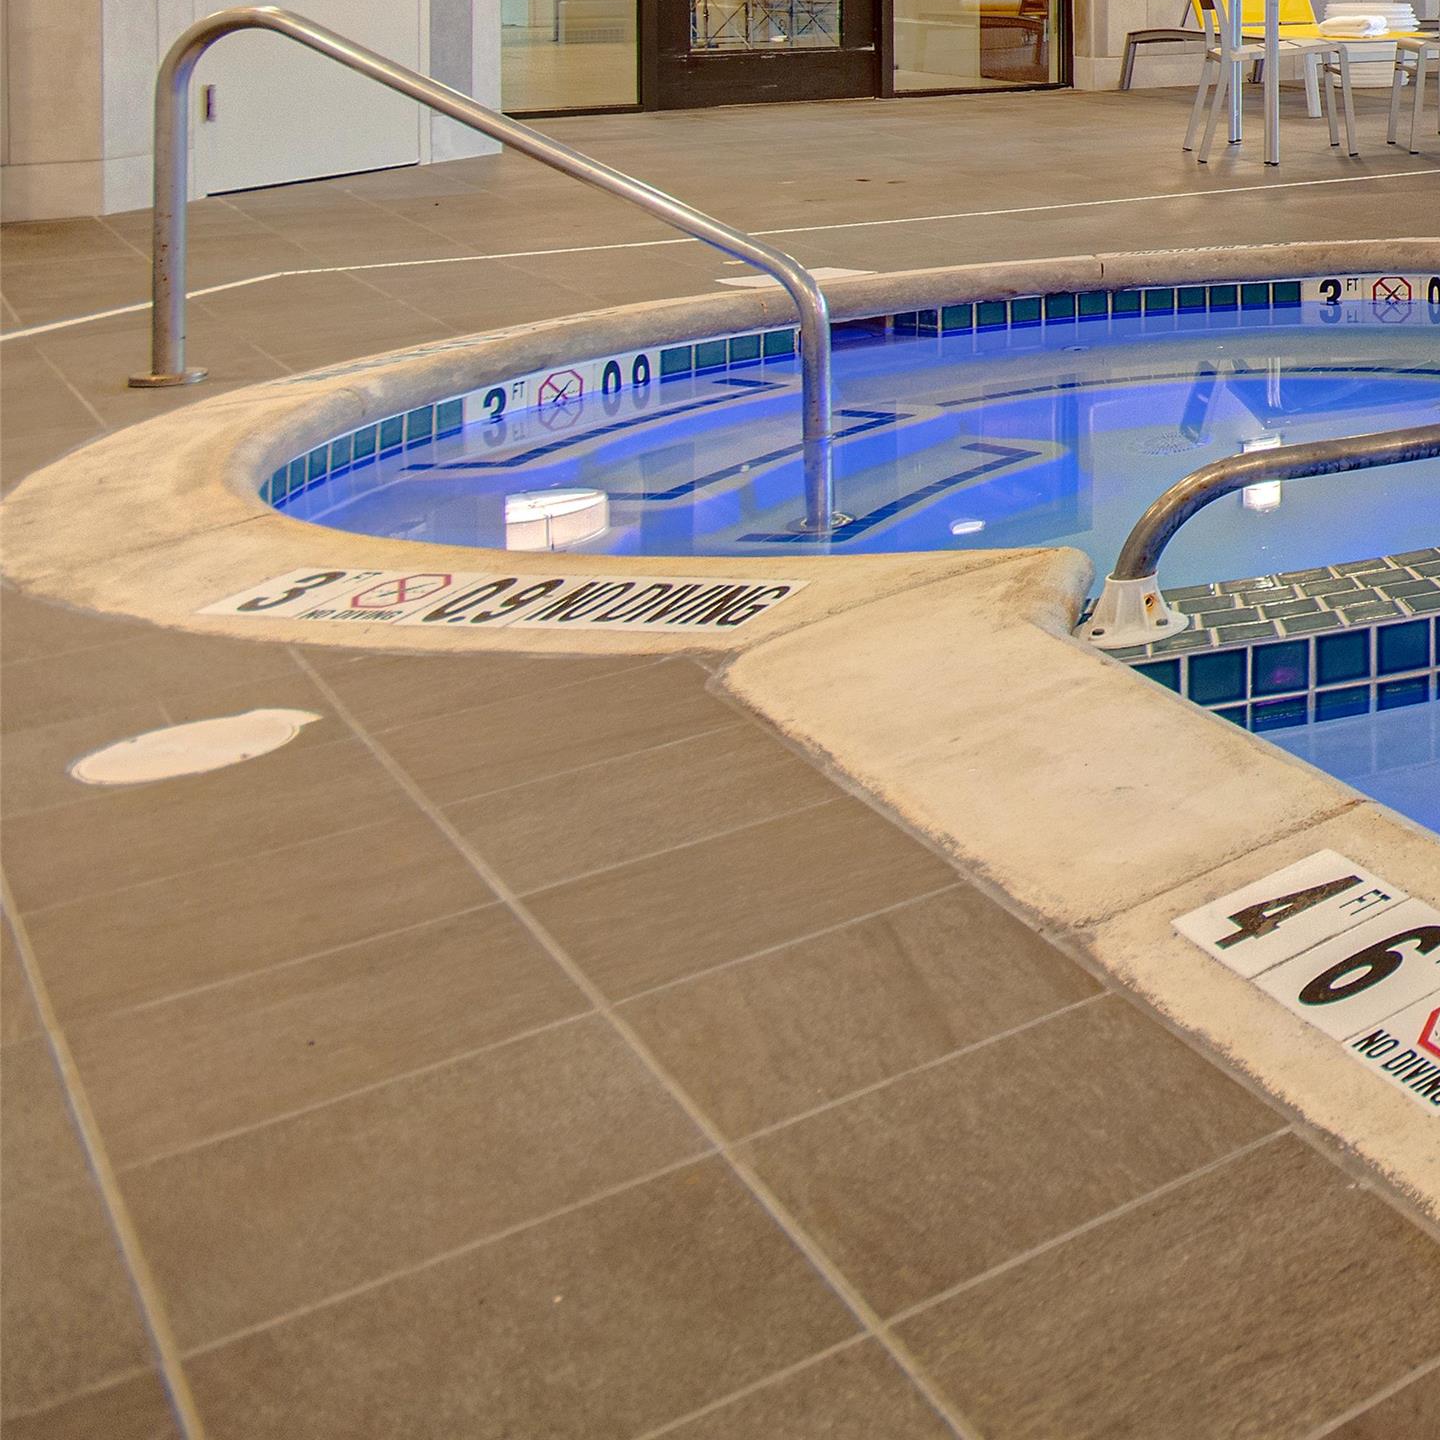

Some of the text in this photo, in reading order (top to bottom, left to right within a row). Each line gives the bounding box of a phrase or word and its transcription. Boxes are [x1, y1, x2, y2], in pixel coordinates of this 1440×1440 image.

[1346, 278, 1359, 292] FT
[512, 381, 525, 400] FT
[236, 571, 791, 627] 3 FT 0.9 NO DIVING
[299, 610, 403, 621] NO DIVING
[1214, 874, 1364, 951] 4
[1338, 886, 1392, 919] FT
[1351, 1028, 1395, 1060] NO
